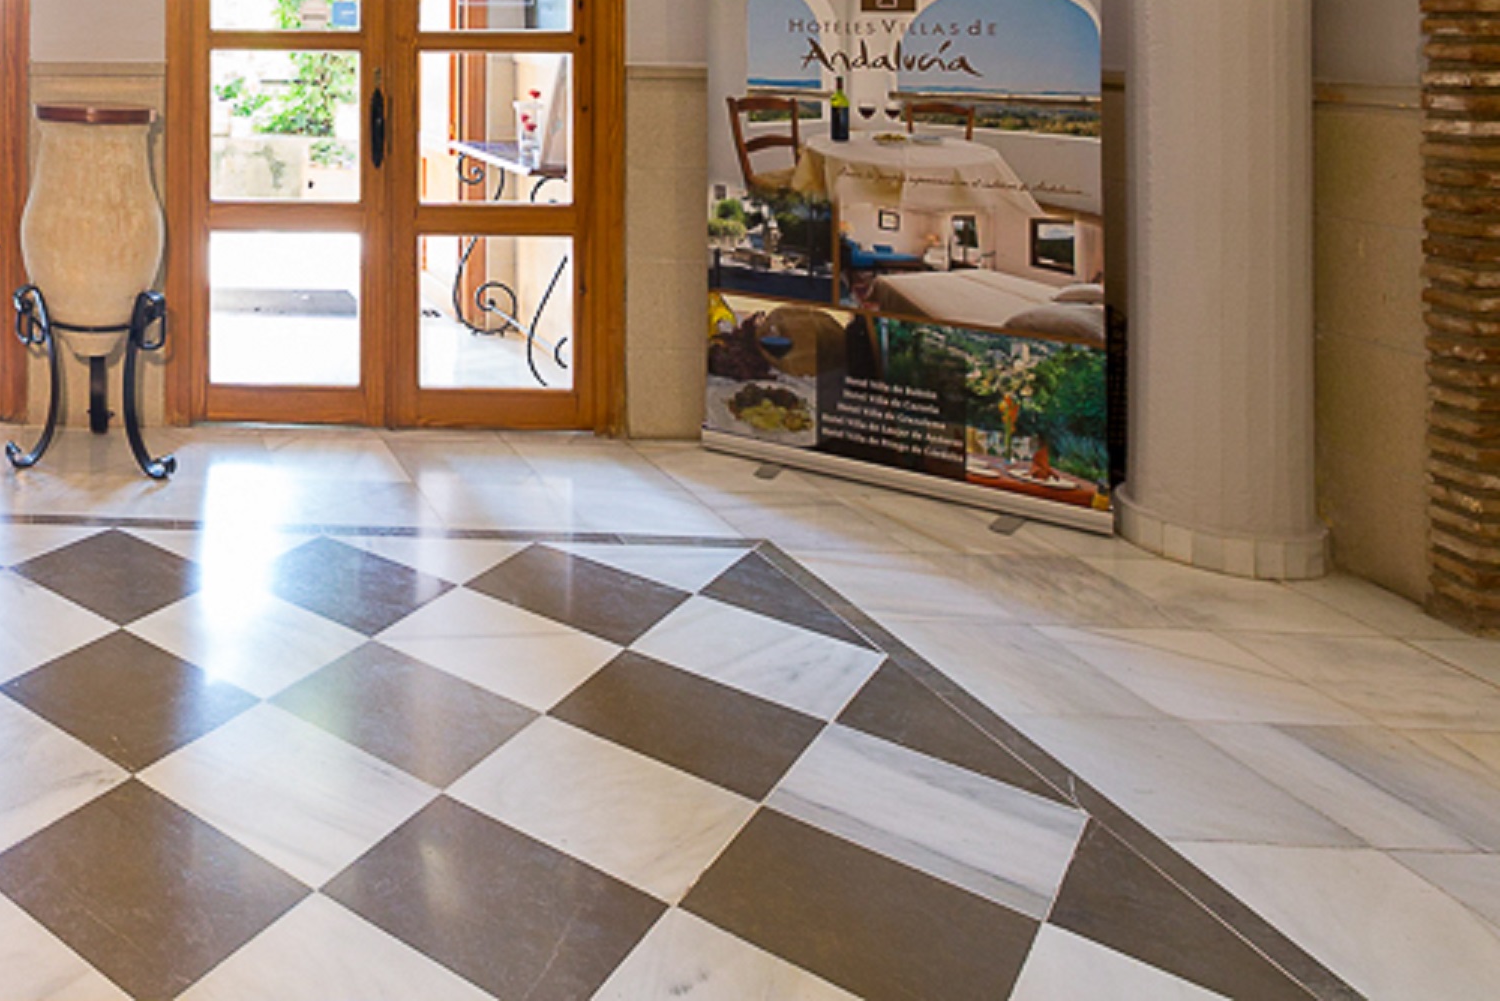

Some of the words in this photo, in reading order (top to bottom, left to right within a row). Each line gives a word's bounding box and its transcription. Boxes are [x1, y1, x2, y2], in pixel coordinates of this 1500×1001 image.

[787, 18, 877, 35] HOTELES
[881, 18, 959, 36] VILLAS
[801, 37, 984, 78] Andalucía
